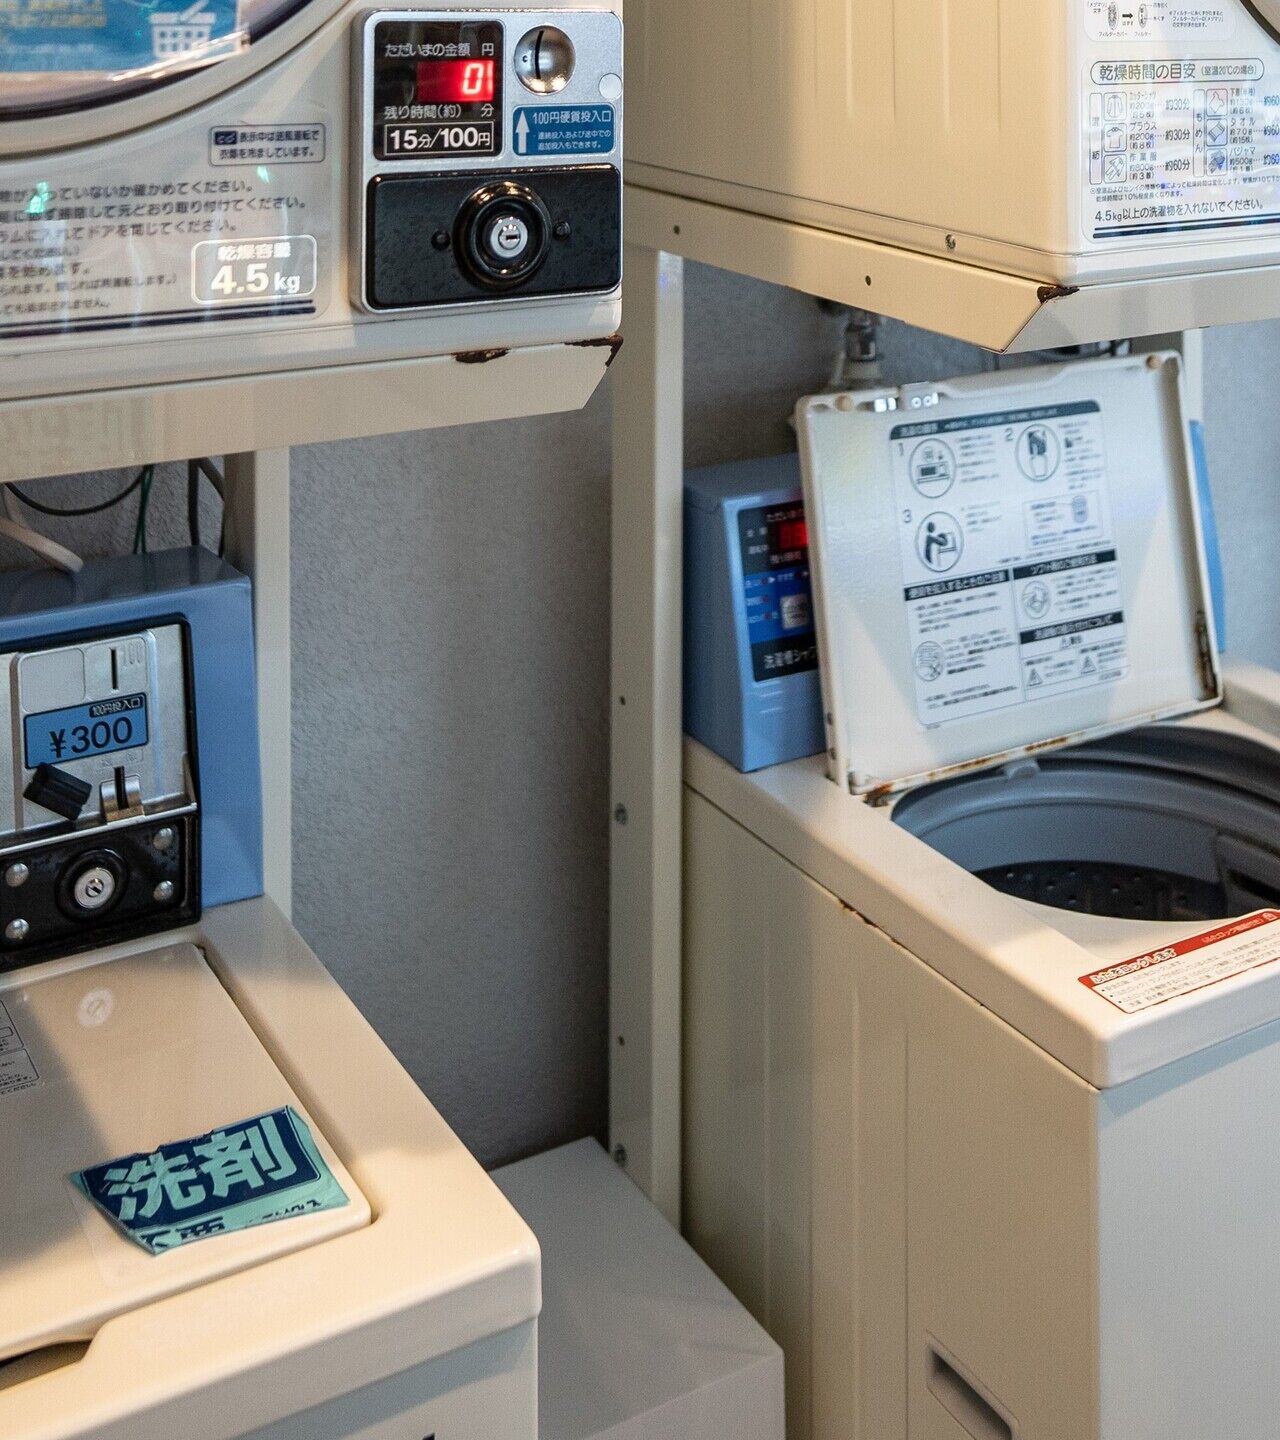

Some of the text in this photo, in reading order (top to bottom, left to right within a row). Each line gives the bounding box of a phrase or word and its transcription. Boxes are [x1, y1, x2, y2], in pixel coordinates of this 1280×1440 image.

[385, 43, 494, 58] ただいまの金額 円
[1099, 63, 1196, 81] 乾燥時間の目安
[384, 103, 495, 120] 残り時間(約) 分
[532, 110, 612, 125] 100円硬貨投入口
[390, 126, 491, 150] 15分/100円
[49, 716, 133, 759] ¥300
[103, 1115, 297, 1221] 洗剤
